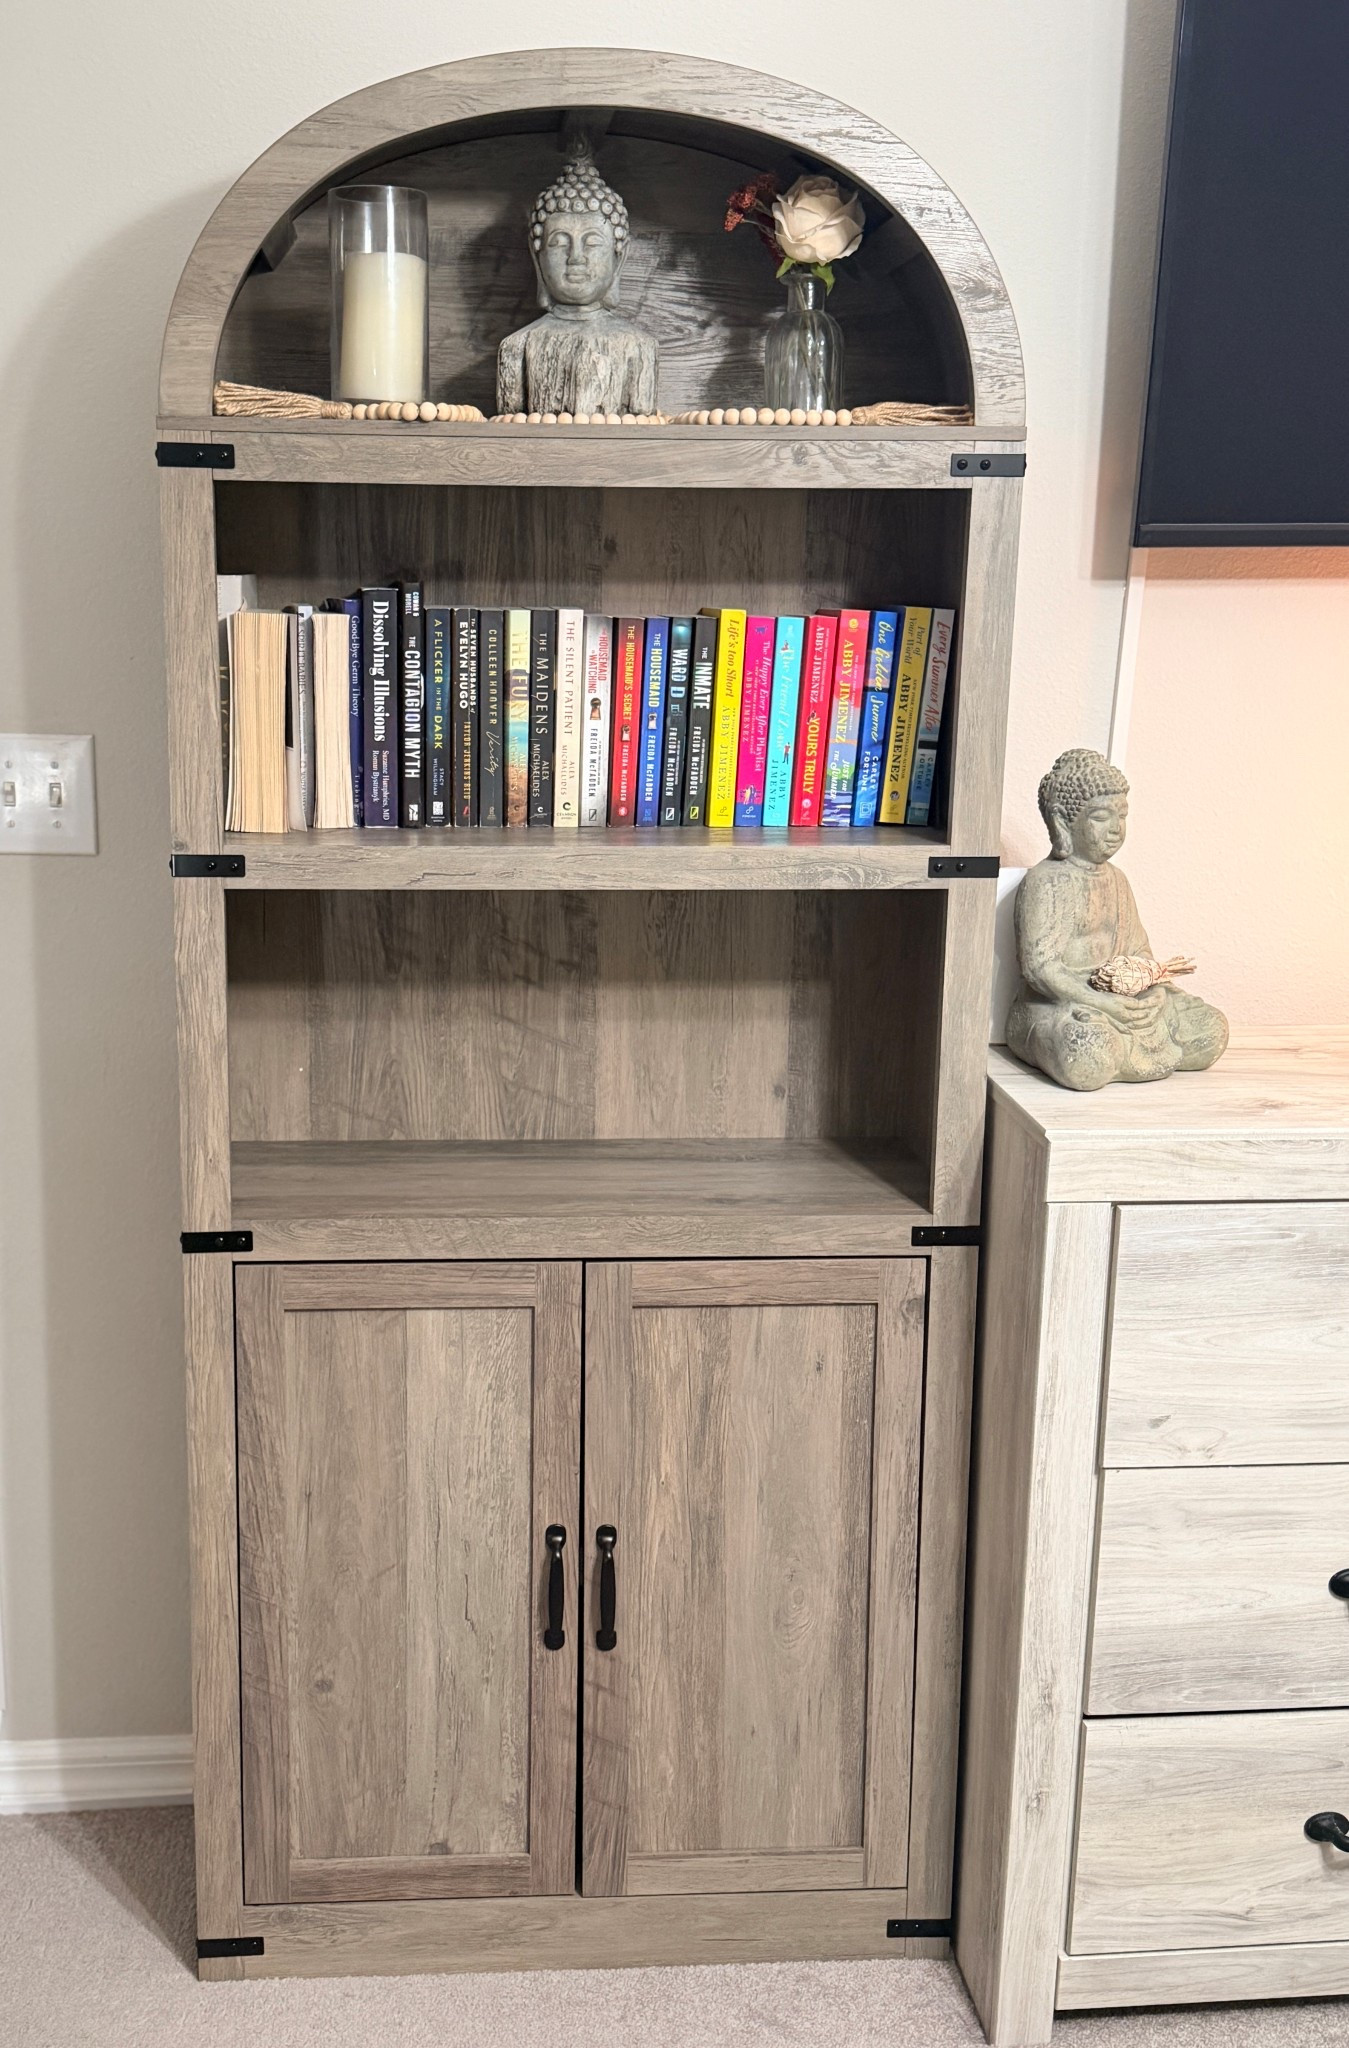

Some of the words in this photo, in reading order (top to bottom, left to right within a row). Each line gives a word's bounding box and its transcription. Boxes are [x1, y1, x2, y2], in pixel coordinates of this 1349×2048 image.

[404, 593, 412, 615] MORELL
[412, 591, 420, 611] COWAN
[350, 615, 360, 658] Good-Bye
[369, 600, 390, 677] Dissolving
[434, 619, 443, 627] A
[565, 621, 575, 641] THE
[627, 625, 636, 640] THE
[653, 633, 661, 647] THE
[727, 619, 740, 649] Life's
[815, 625, 825, 653] ABBY
[878, 621, 894, 644] One
[908, 617, 917, 637] Your
[916, 626, 926, 645] Part
[932, 621, 951, 655] Every
[408, 636, 417, 648] THE
[434, 631, 443, 684] FLICKER
[459, 621, 469, 669] EVELYN
[488, 629, 498, 676] COLLEEN
[511, 630, 528, 667] THE
[539, 632, 547, 652] THE
[597, 635, 608, 682] HOUSEMAID
[701, 646, 709, 659] THE
[727, 650, 737, 667] too
[762, 640, 771, 655] The
[841, 639, 855, 677] ABBY
[904, 640, 914, 665] World
[913, 646, 921, 657] of
[352, 660, 360, 684] Germ
[565, 647, 575, 684] SILENT
[587, 654, 598, 694] WATCHING
[624, 642, 635, 691] HOUSEMAID'S
[648, 648, 663, 708] HOUSEMAID
[671, 648, 689, 682] WARD
[758, 656, 772, 688] Happy
[809, 656, 822, 704] JIMENEZ
[874, 647, 890, 692] Golden
[929, 656, 946, 705] Summer
[404, 650, 421, 733] CONTAGION
[436, 687, 442, 695] IN
[459, 673, 469, 709] HUGO
[469, 660, 477, 706] HUSBANDS
[510, 675, 528, 719] FURY
[535, 657, 549, 734] MAIDENS
[670, 686, 686, 698] D
[692, 661, 713, 710] INMATE
[725, 667, 737, 698] Short
[745, 670, 753, 695] ABBY
[759, 688, 769, 711] Ever
[898, 673, 911, 712] ABBY
[350, 687, 360, 717] Theory
[373, 679, 390, 742] Illusions
[488, 680, 498, 725] HOOVER
[563, 690, 574, 736] PATIENT
[622, 693, 633, 721] SECRET
[836, 680, 851, 743] JIMENEZ
[870, 695, 884, 743] Summer
[923, 705, 940, 732] After
[434, 715, 443, 750] DARK
[463, 721, 471, 747] TAYLOR
[721, 705, 731, 737] ABBY
[742, 699, 752, 742] JIMENEZ
[755, 713, 767, 736] After
[805, 717, 821, 758] YOURS
[484, 731, 501, 777] Verity
[589, 728, 598, 755] FREIDA
[622, 745, 630, 767] FREIDA
[647, 735, 657, 762] FREIDA
[668, 727, 678, 754] FREIDA
[692, 726, 702, 753] FREIDA
[754, 736, 766, 772] Playlist
[890, 715, 906, 783] JIMENEZ
[372, 750, 380, 771] Roman
[404, 738, 421, 778] MYTH
[463, 749, 471, 780] JENKINS
[532, 743, 541, 798] MICHAELIDES
[541, 760, 550, 781] ALEX
[560, 744, 568, 796] MICHAELIDES
[568, 760, 576, 779] ALEX
[717, 744, 728, 800] JIMENEZ
[842, 759, 850, 780] JUST
[860, 751, 871, 792] FORTUNE
[869, 755, 879, 790] CARLEY
[916, 753, 925, 790] FORTUNE
[925, 757, 934, 788] CARLEY
[463, 783, 471, 800] REID
[588, 758, 597, 797] McFADDEN
[620, 769, 629, 802] McFADDEN
[644, 763, 655, 802] McFADDEN
[665, 758, 676, 797] McFADDEN
[689, 756, 700, 796] McFADDEN
[768, 759, 779, 810] JIMENEZ
[778, 770, 787, 800] ABBY
[802, 759, 817, 794] TRULY
[830, 761, 840, 800] SUMMER
[382, 809, 390, 821] MD
